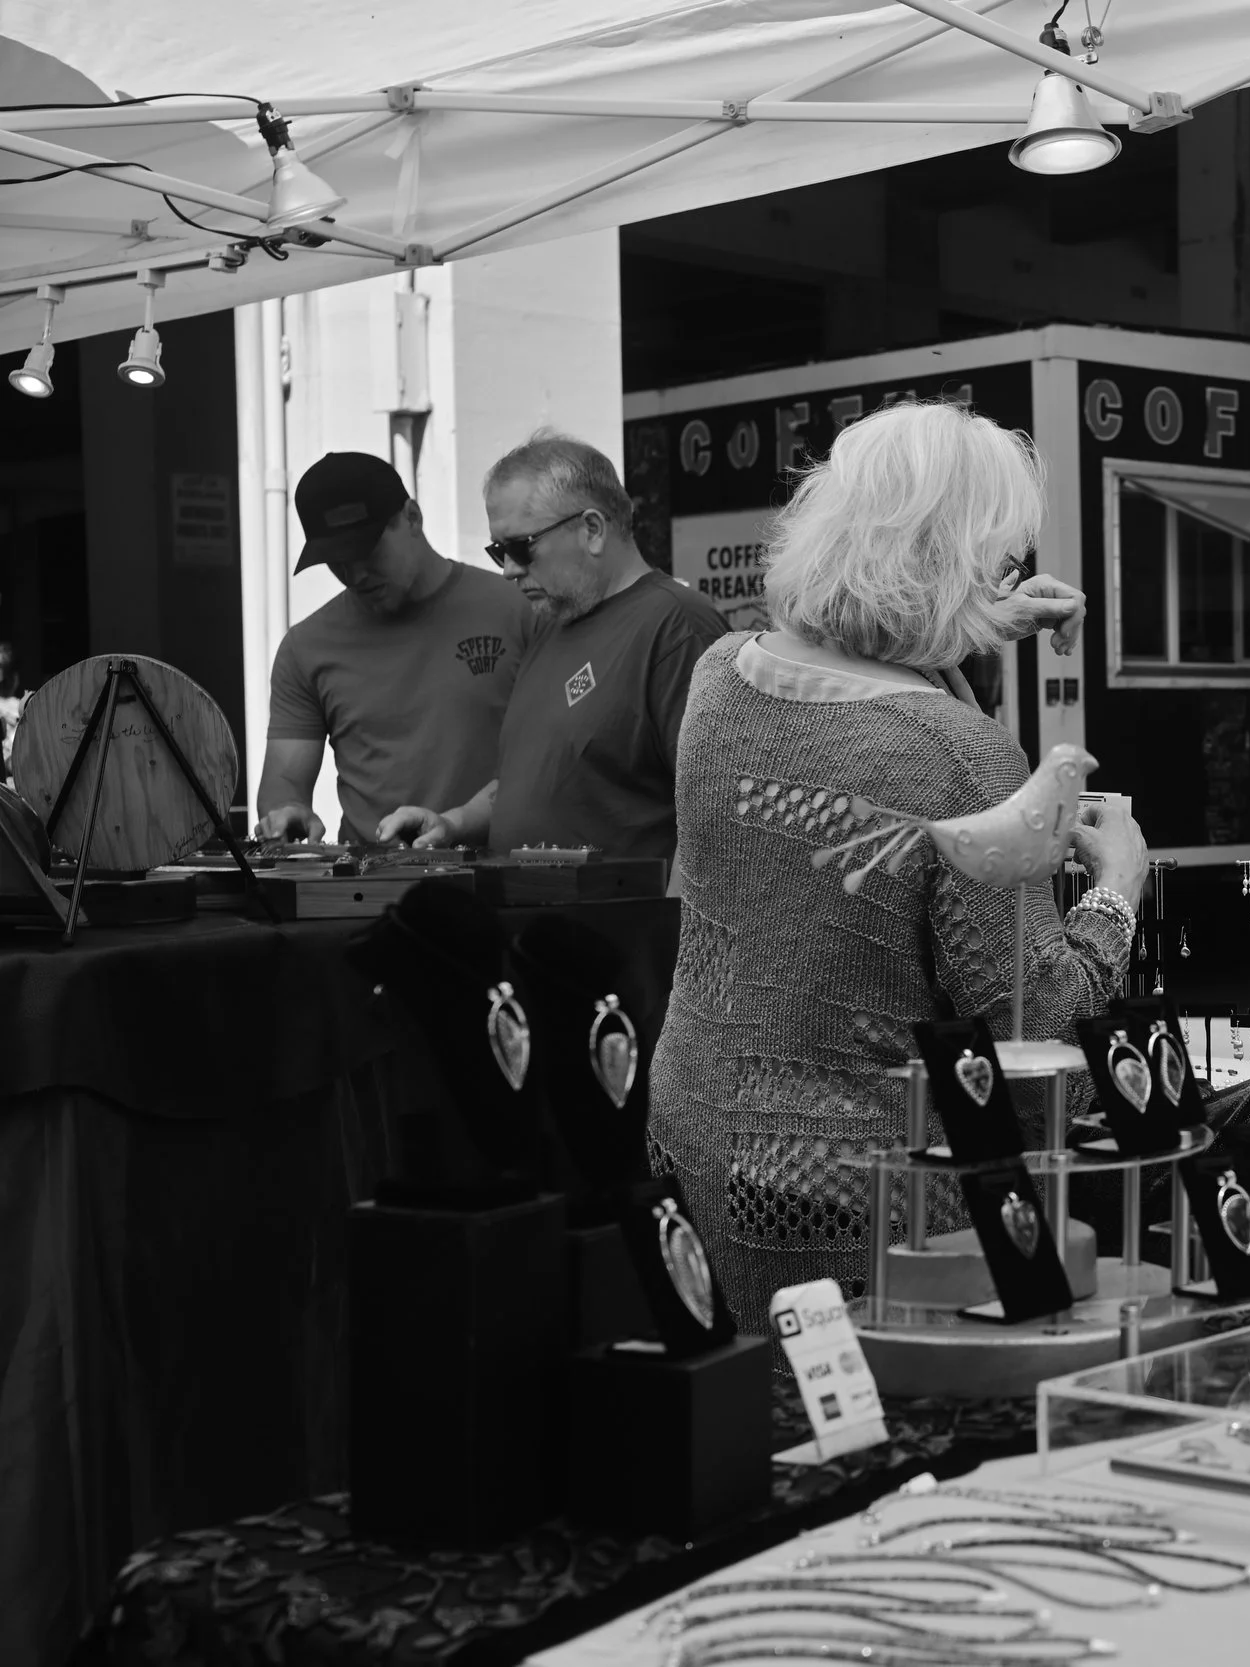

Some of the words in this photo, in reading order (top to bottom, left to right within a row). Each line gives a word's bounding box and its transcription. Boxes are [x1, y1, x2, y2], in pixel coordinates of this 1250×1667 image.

[707, 544, 769, 571] COFF
[457, 635, 503, 657] SPEED
[467, 655, 499, 677] GOAT
[801, 1305, 848, 1330] Squa
[807, 1362, 833, 1381] VISA
